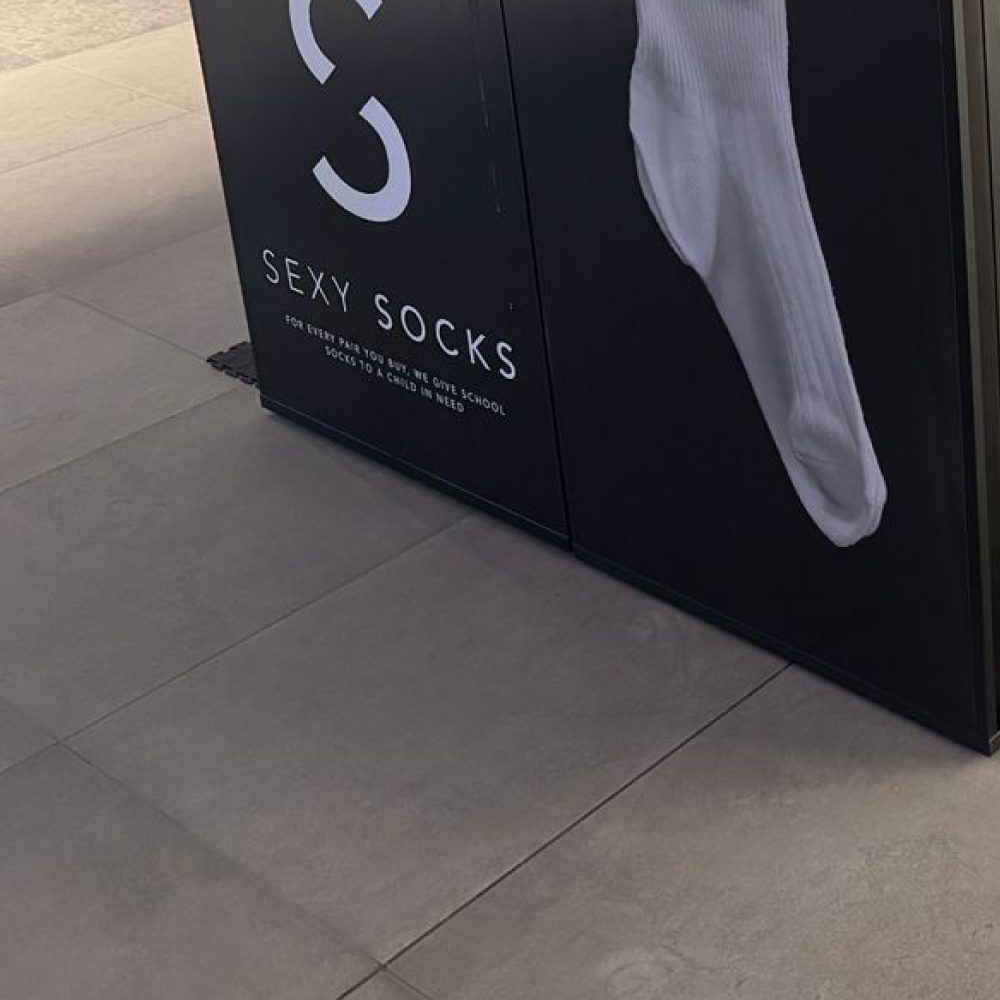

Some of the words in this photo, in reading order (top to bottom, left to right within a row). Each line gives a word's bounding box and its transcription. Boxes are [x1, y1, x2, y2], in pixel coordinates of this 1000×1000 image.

[262, 249, 351, 313] SEXY
[374, 293, 517, 380] SOCKS
[285, 314, 304, 332] FOR
[307, 323, 336, 344] EVERY
[339, 336, 361, 355] PAIR
[364, 348, 384, 366] YOU
[387, 357, 410, 377] BUY,
[412, 368, 429, 385] WE
[432, 376, 458, 397] GIVE
[461, 387, 506, 417] SCHOOL
[324, 345, 357, 368] SOCKS
[359, 359, 373, 375] TO
[376, 368, 384, 379] A
[386, 371, 417, 393] CHILD
[420, 386, 433, 400] IN
[436, 392, 465, 414] NEED
